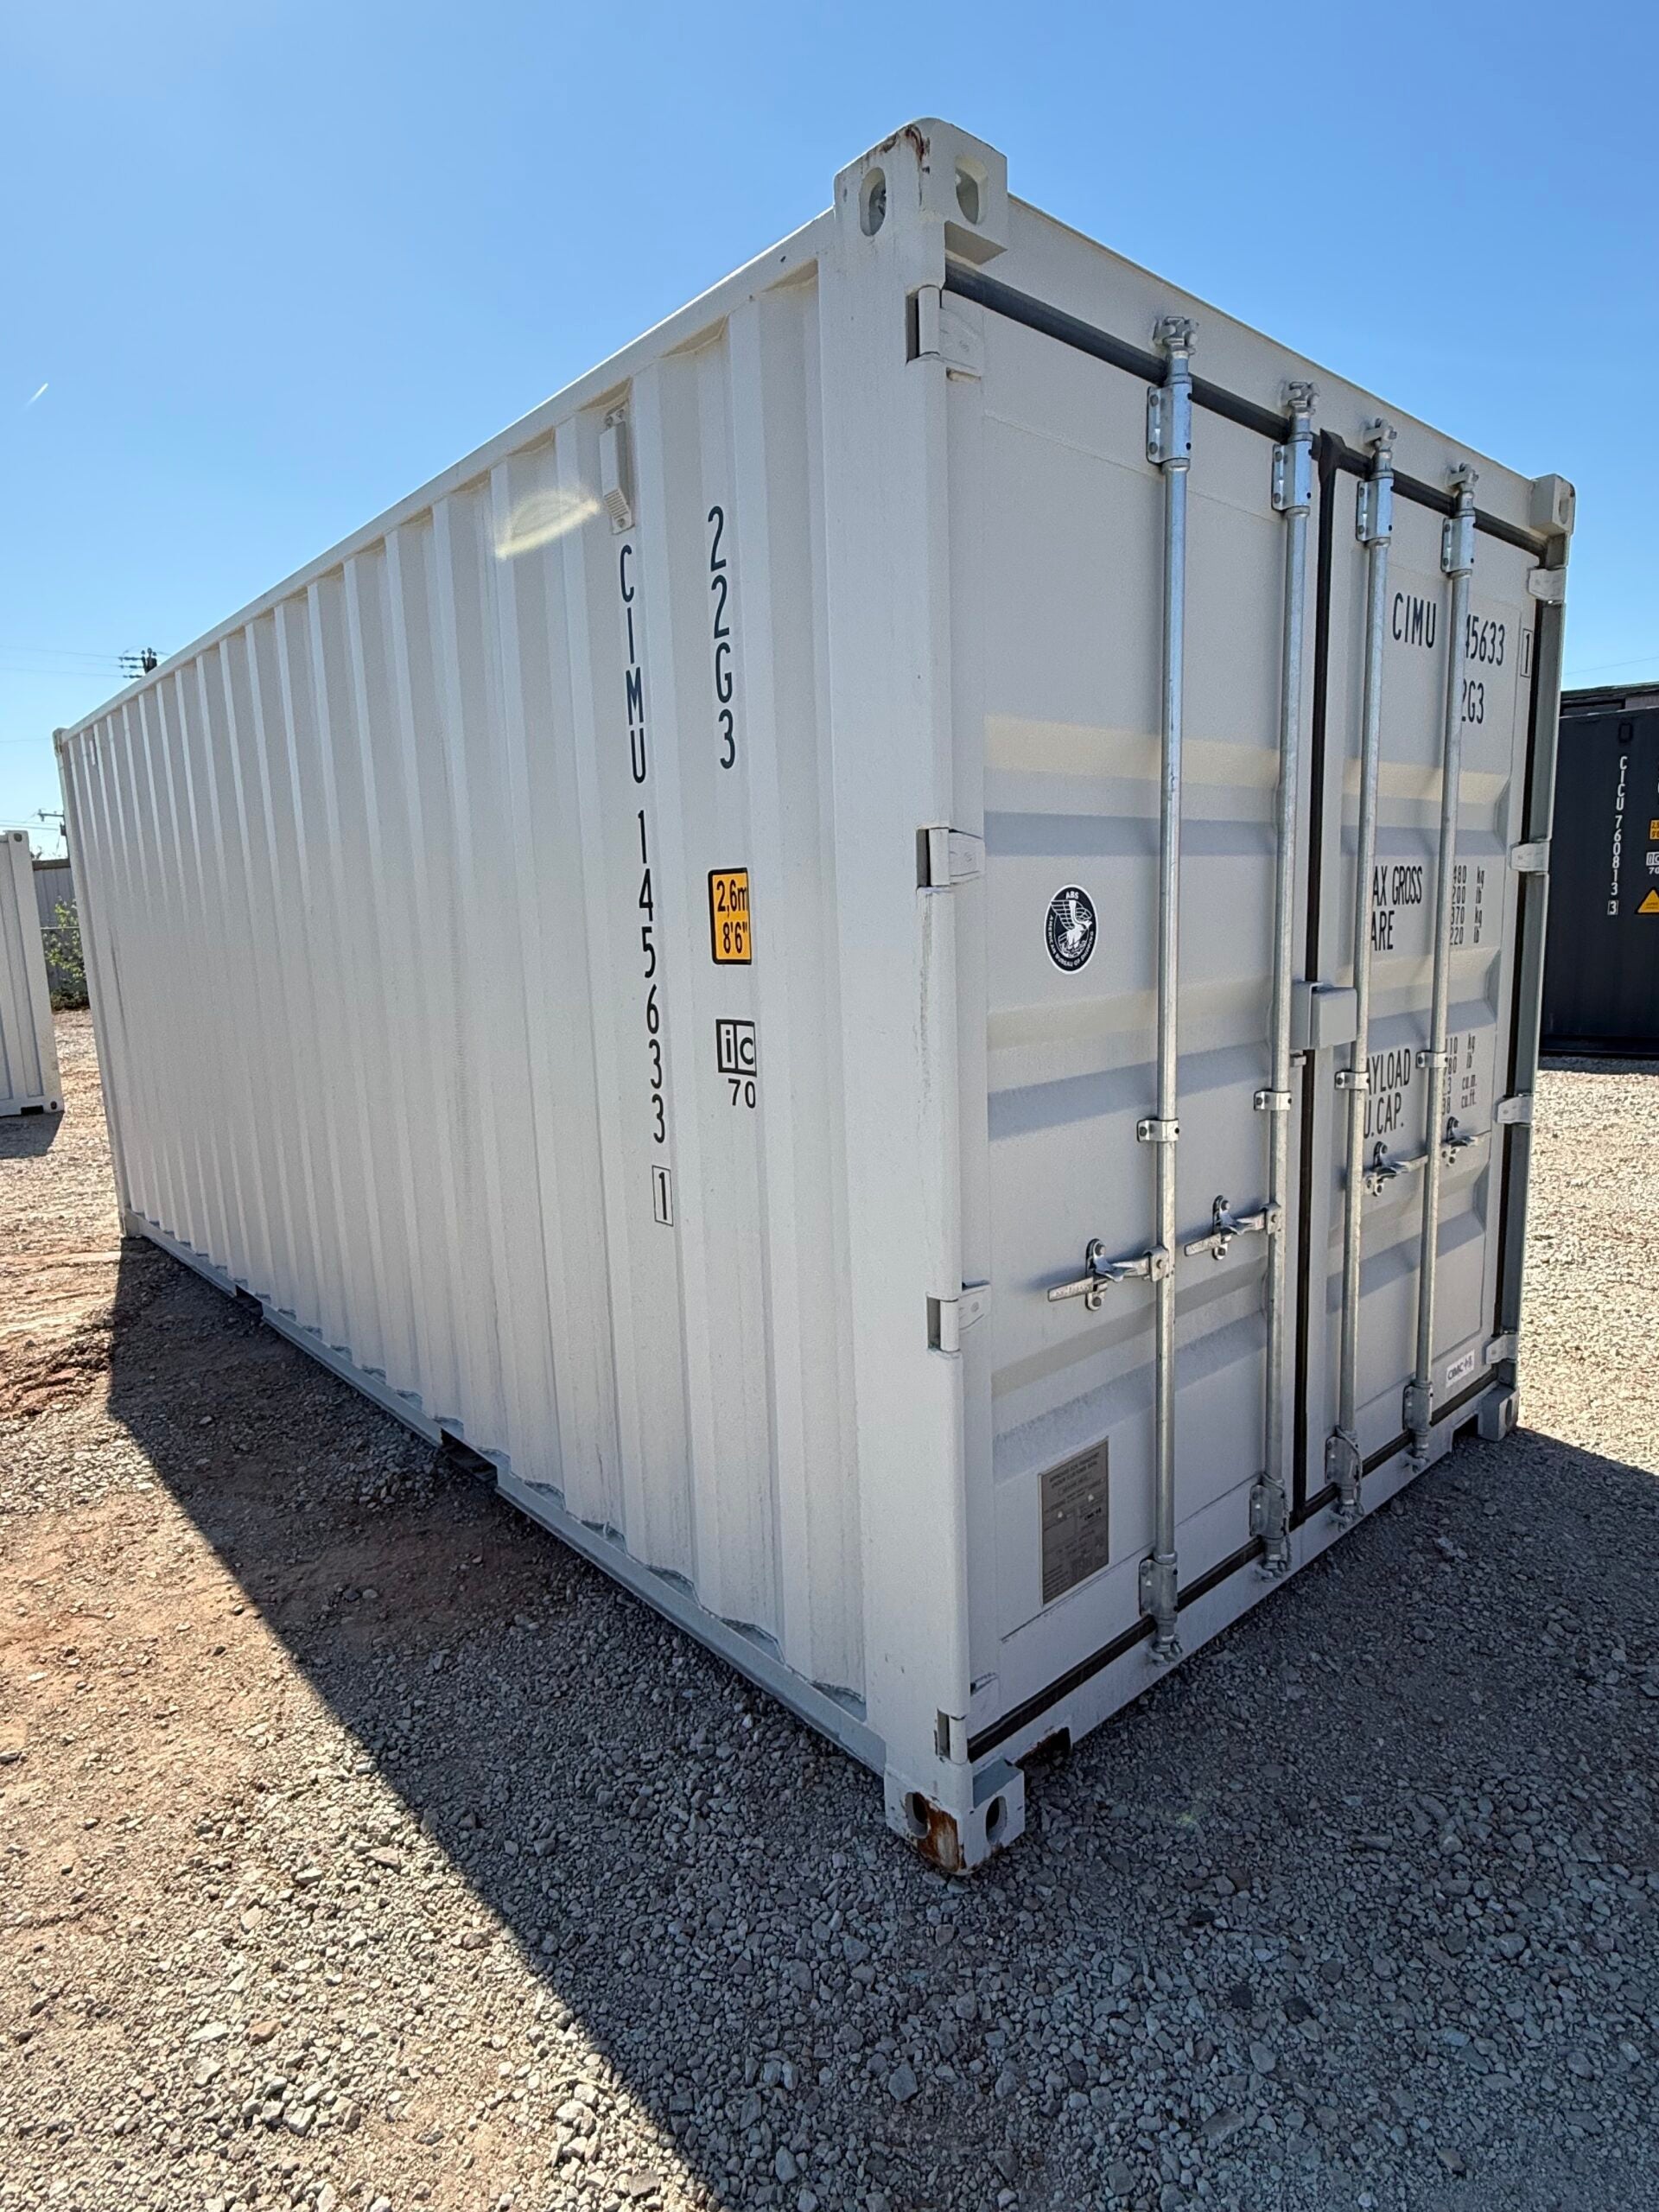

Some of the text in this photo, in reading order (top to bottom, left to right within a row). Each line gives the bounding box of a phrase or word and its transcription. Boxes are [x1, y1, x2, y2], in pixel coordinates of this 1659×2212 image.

[708, 505, 735, 770] 22G3
[1392, 592, 1437, 649] CIMU
[1615, 755, 1628, 811] CICU
[620, 544, 646, 784] CIMU
[638, 810, 665, 1144] 145633
[1610, 814, 1624, 896] 760813
[1065, 891, 1079, 900] ABS
[1372, 865, 1389, 906] AX
[1391, 865, 1423, 906] GROSS
[1477, 866, 1484, 889] kg
[1475, 886, 1483, 904] lb
[1370, 910, 1395, 951] ARE
[1474, 906, 1483, 928] kg
[728, 1077, 756, 1109] 70
[1365, 1048, 1411, 1096] AYLOAD
[1363, 1091, 1404, 1139] U.CAP.
